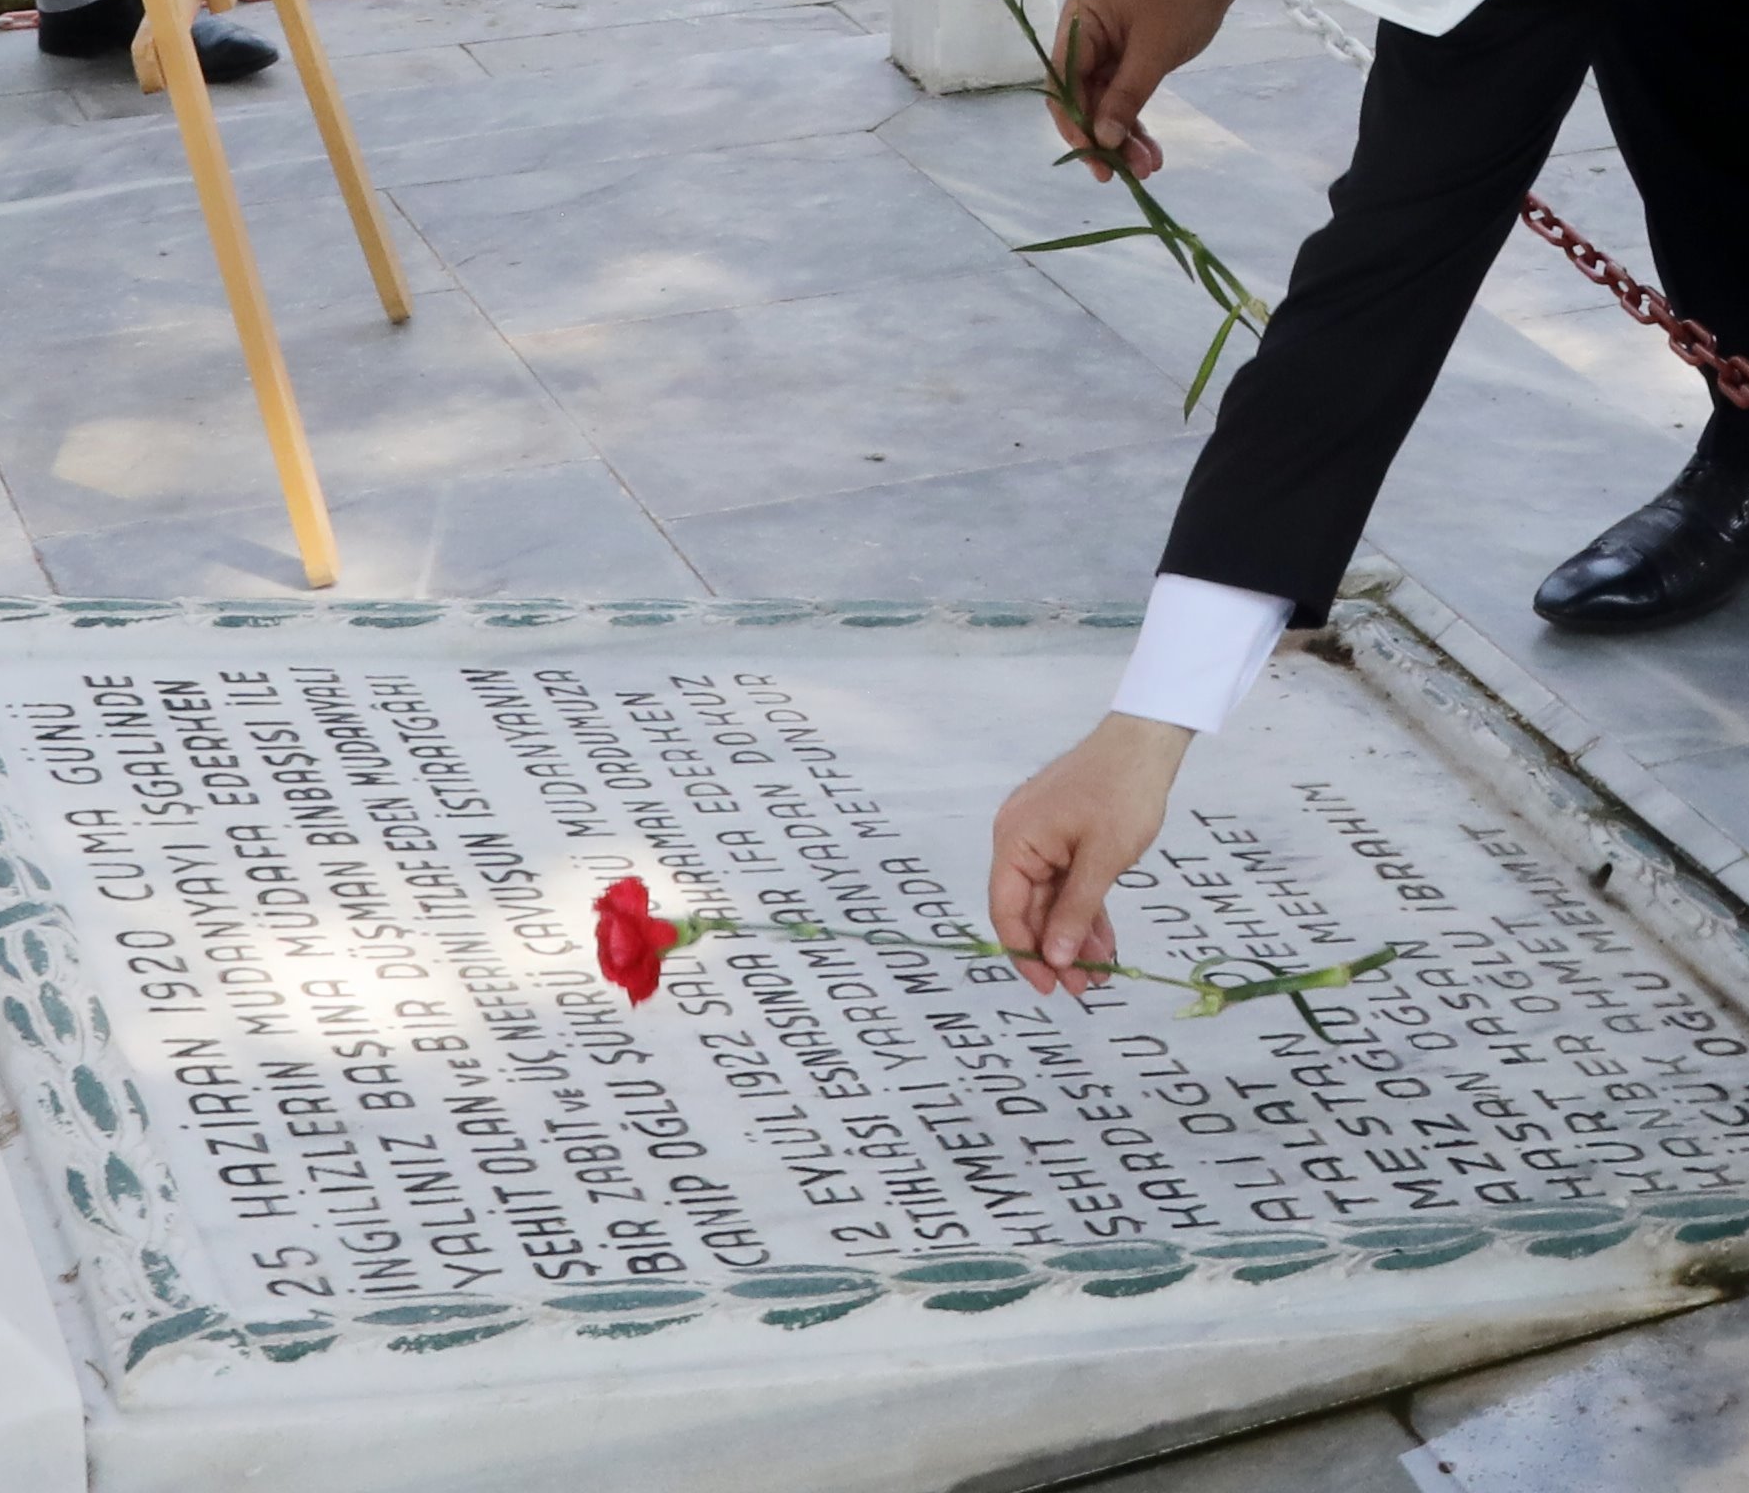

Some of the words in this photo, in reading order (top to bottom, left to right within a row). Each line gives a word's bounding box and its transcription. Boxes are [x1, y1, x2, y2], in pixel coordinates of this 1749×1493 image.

[218, 671, 283, 706] İLE
[288, 667, 401, 786] MUDANYALI
[532, 670, 653, 790] ORDUMUZA
[5, 703, 103, 785] GÜNÜ
[81, 675, 204, 826] İŞGALİNDE
[243, 721, 360, 846] BİNBAŞISI
[459, 669, 617, 837] MUDANYANIN
[733, 674, 901, 839] METFUNDUR
[64, 809, 155, 901] CUMA
[361, 797, 438, 852] EDEN
[715, 830, 785, 874] İFA
[1291, 783, 1458, 912] İBRAHİM
[225, 825, 334, 957] MÜDAFA
[318, 861, 430, 979] DÜŞMAN
[396, 860, 476, 921] İTLAF
[458, 833, 583, 955] ÇAVUŞUN
[753, 784, 954, 995] MUDANYADAN
[1190, 809, 1356, 944] MEHMET
[1458, 824, 1634, 954] MEHMET
[115, 930, 207, 1013] 1920
[161, 844, 297, 1035] MUDANYAYI
[420, 932, 546, 1041] NEFERİNİ
[1439, 930, 1561, 1014] OĞLU
[1490, 914, 1655, 1034] AHMET
[301, 980, 417, 1110] BAŞINA
[394, 1000, 470, 1052] BİR
[725, 954, 872, 1100] ESNASINDA
[1295, 1005, 1432, 1099] OĞLU
[1381, 940, 1548, 1065] HASAN
[1617, 971, 1749, 1058] OĞLU
[497, 1049, 571, 1083] ÜÇ
[698, 1030, 791, 1099] 1922
[924, 1012, 1048, 1116] DÜŞEN
[1108, 1034, 1238, 1135] OĞLU
[161, 1038, 298, 1219] HAZİRAN
[442, 1096, 539, 1175] OLAN
[539, 1118, 647, 1204] ZABİT
[604, 1079, 708, 1160] OĞLU
[744, 1104, 866, 1206] EYLÜL
[1225, 1076, 1380, 1215] TALAT
[1258, 1033, 1461, 1211] MESTAN
[1410, 1113, 1547, 1209] AZİZ
[1438, 1070, 1607, 1203] HASAN
[252, 1061, 423, 1294] İNGİLİZLERİN
[377, 1134, 504, 1289] YALINIZ
[663, 1174, 771, 1270] CANİP
[1019, 1136, 1148, 1237] ŞEHİT
[1199, 1156, 1316, 1222] ALİ
[251, 1246, 336, 1297] 25
[486, 1185, 603, 1280] ŞEHİT
[597, 1219, 688, 1275] BİR
[829, 1221, 903, 1257] 12
